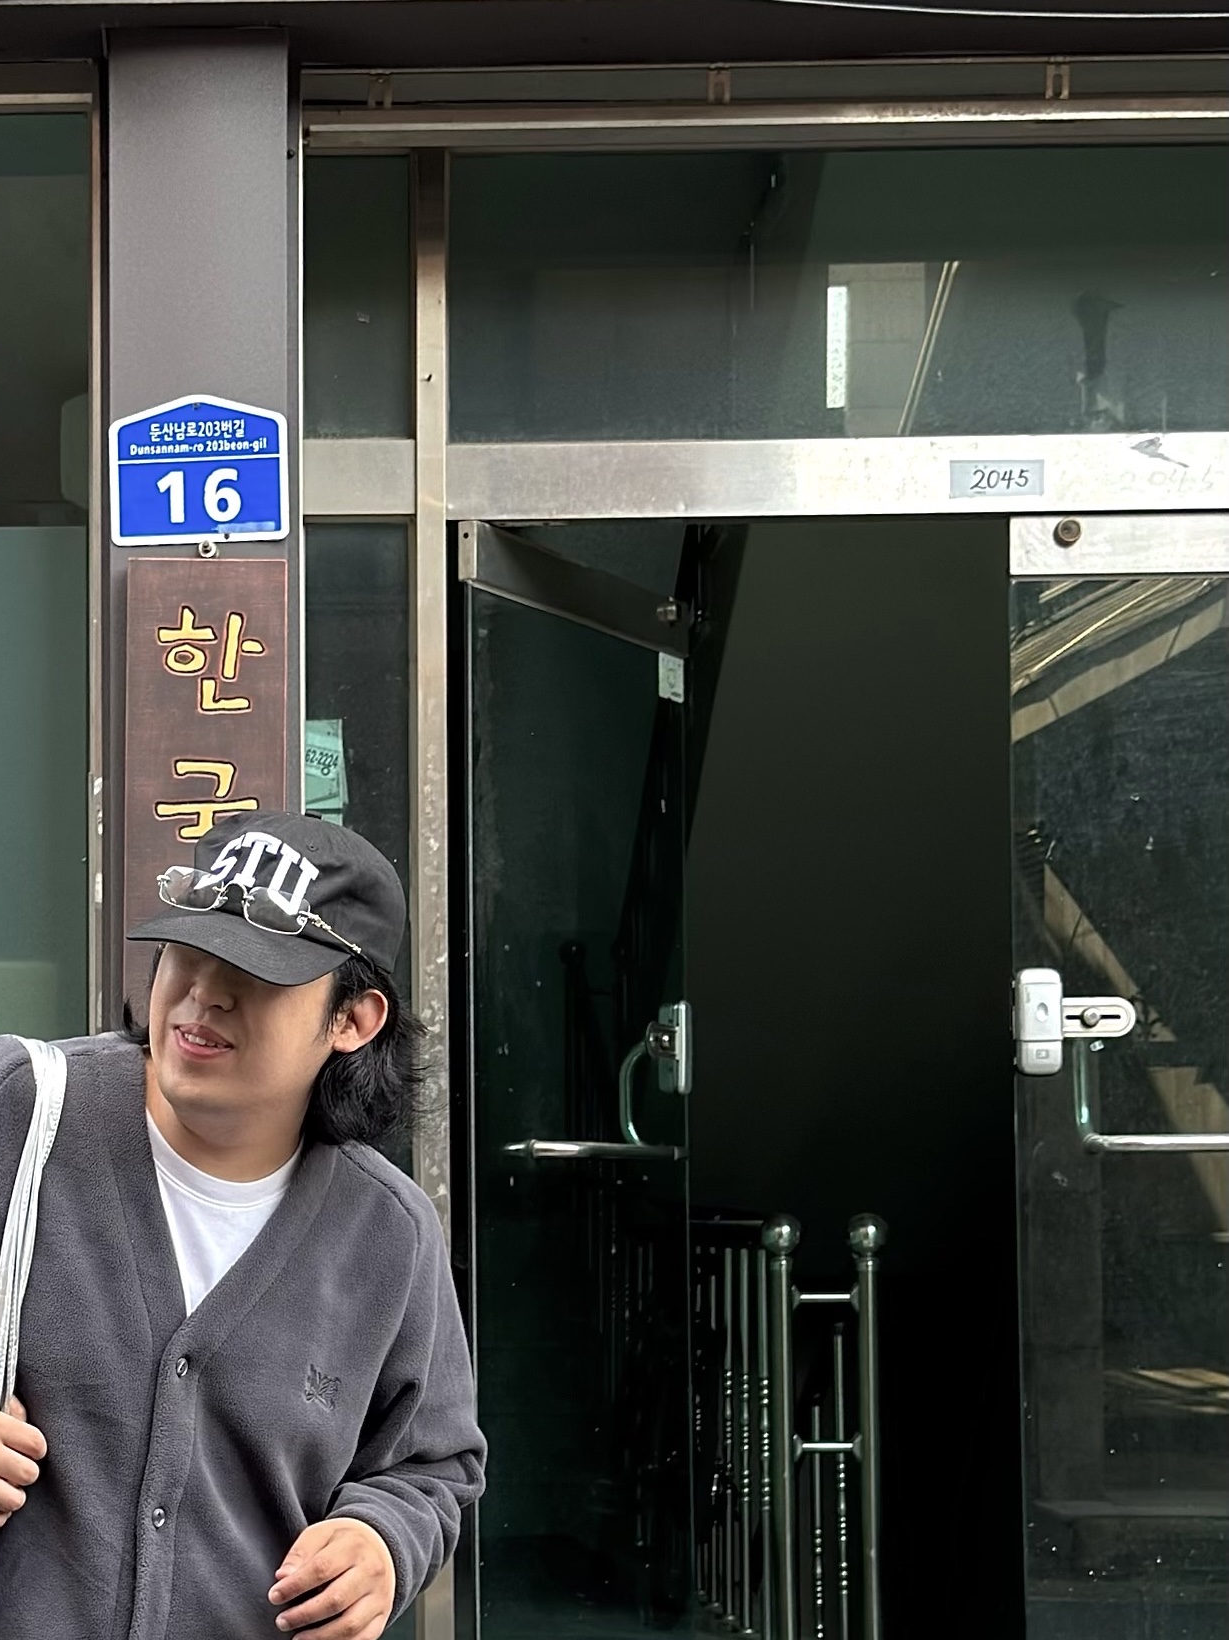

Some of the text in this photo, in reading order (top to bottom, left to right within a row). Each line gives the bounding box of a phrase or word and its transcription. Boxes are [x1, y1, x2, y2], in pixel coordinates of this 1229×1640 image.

[149, 418, 245, 442] 둔산남로203번길
[129, 437, 268, 456] Dunsannam-ro 203beon-gil
[970, 468, 1030, 489] 2045
[156, 467, 242, 524] 16
